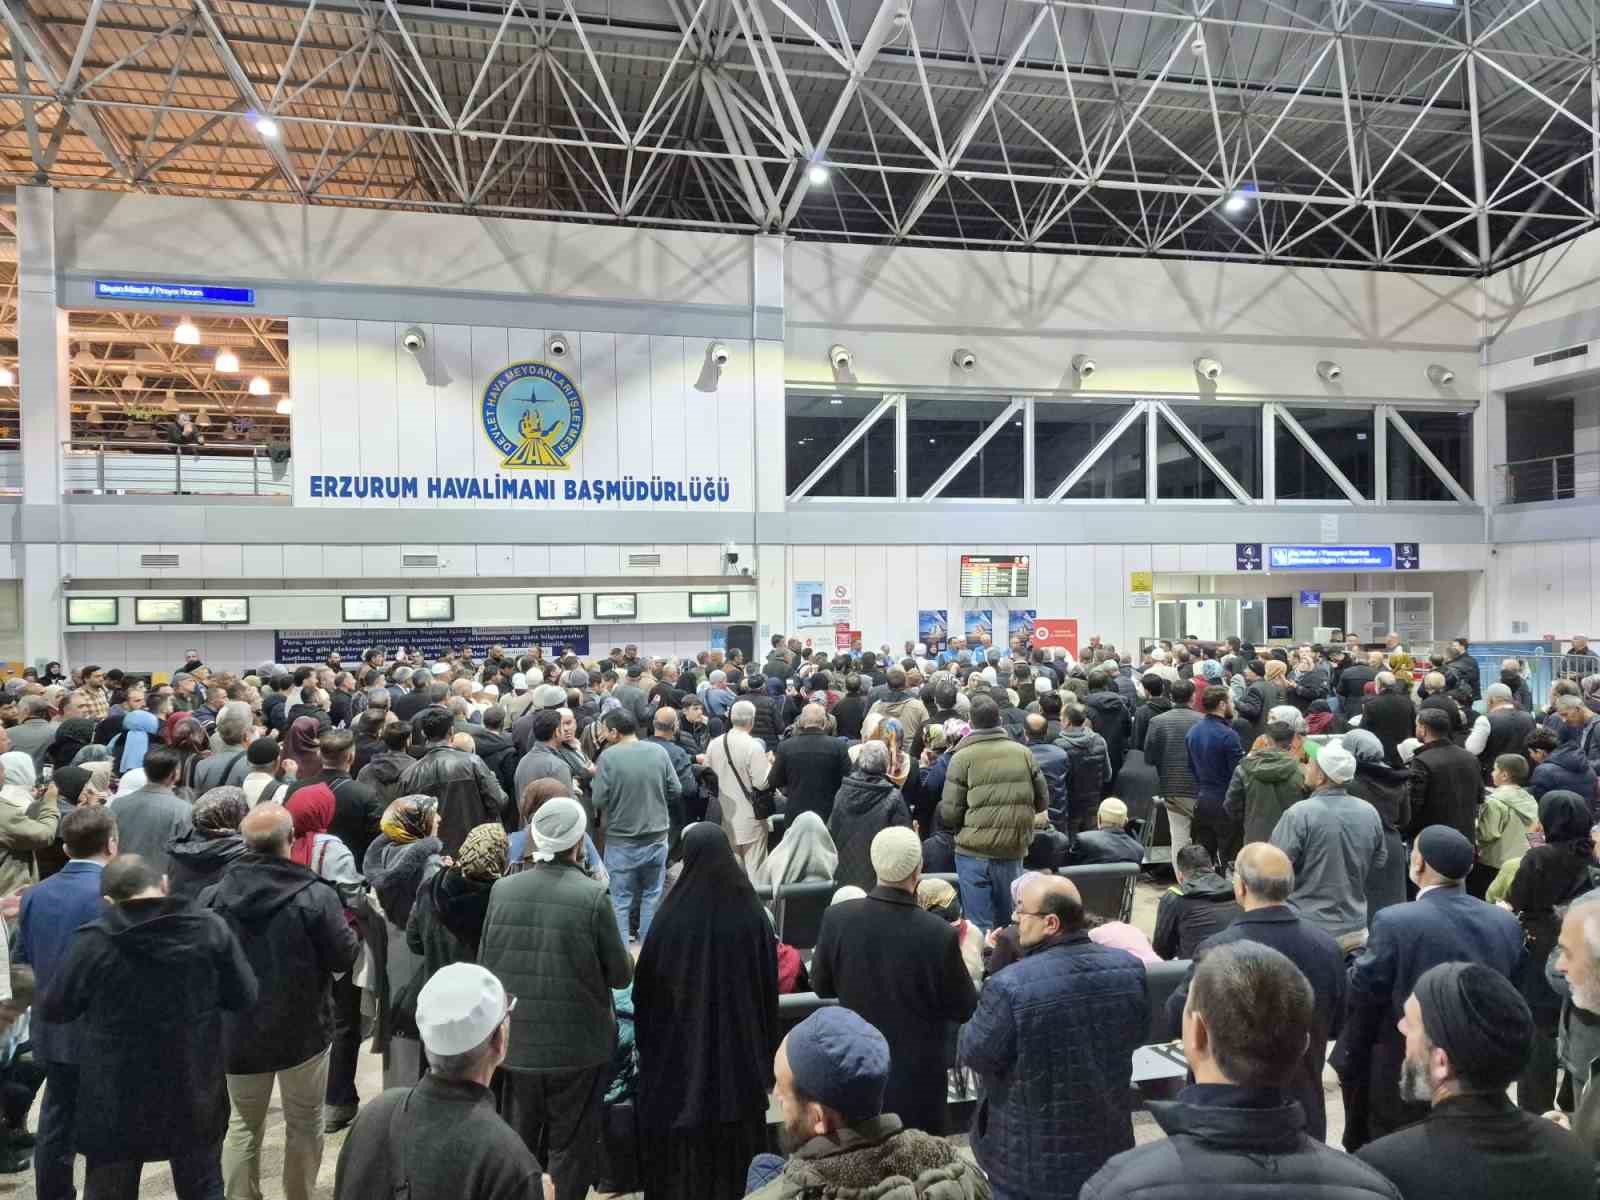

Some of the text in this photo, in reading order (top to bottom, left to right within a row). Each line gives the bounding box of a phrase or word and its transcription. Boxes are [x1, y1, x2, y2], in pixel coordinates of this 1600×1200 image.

[487, 380, 507, 408] HAVA
[487, 411, 511, 452] DEVLET
[310, 473, 730, 504] ERZURUM HAVALİMANI BAŞMÜDÜRLÜĞÜ
